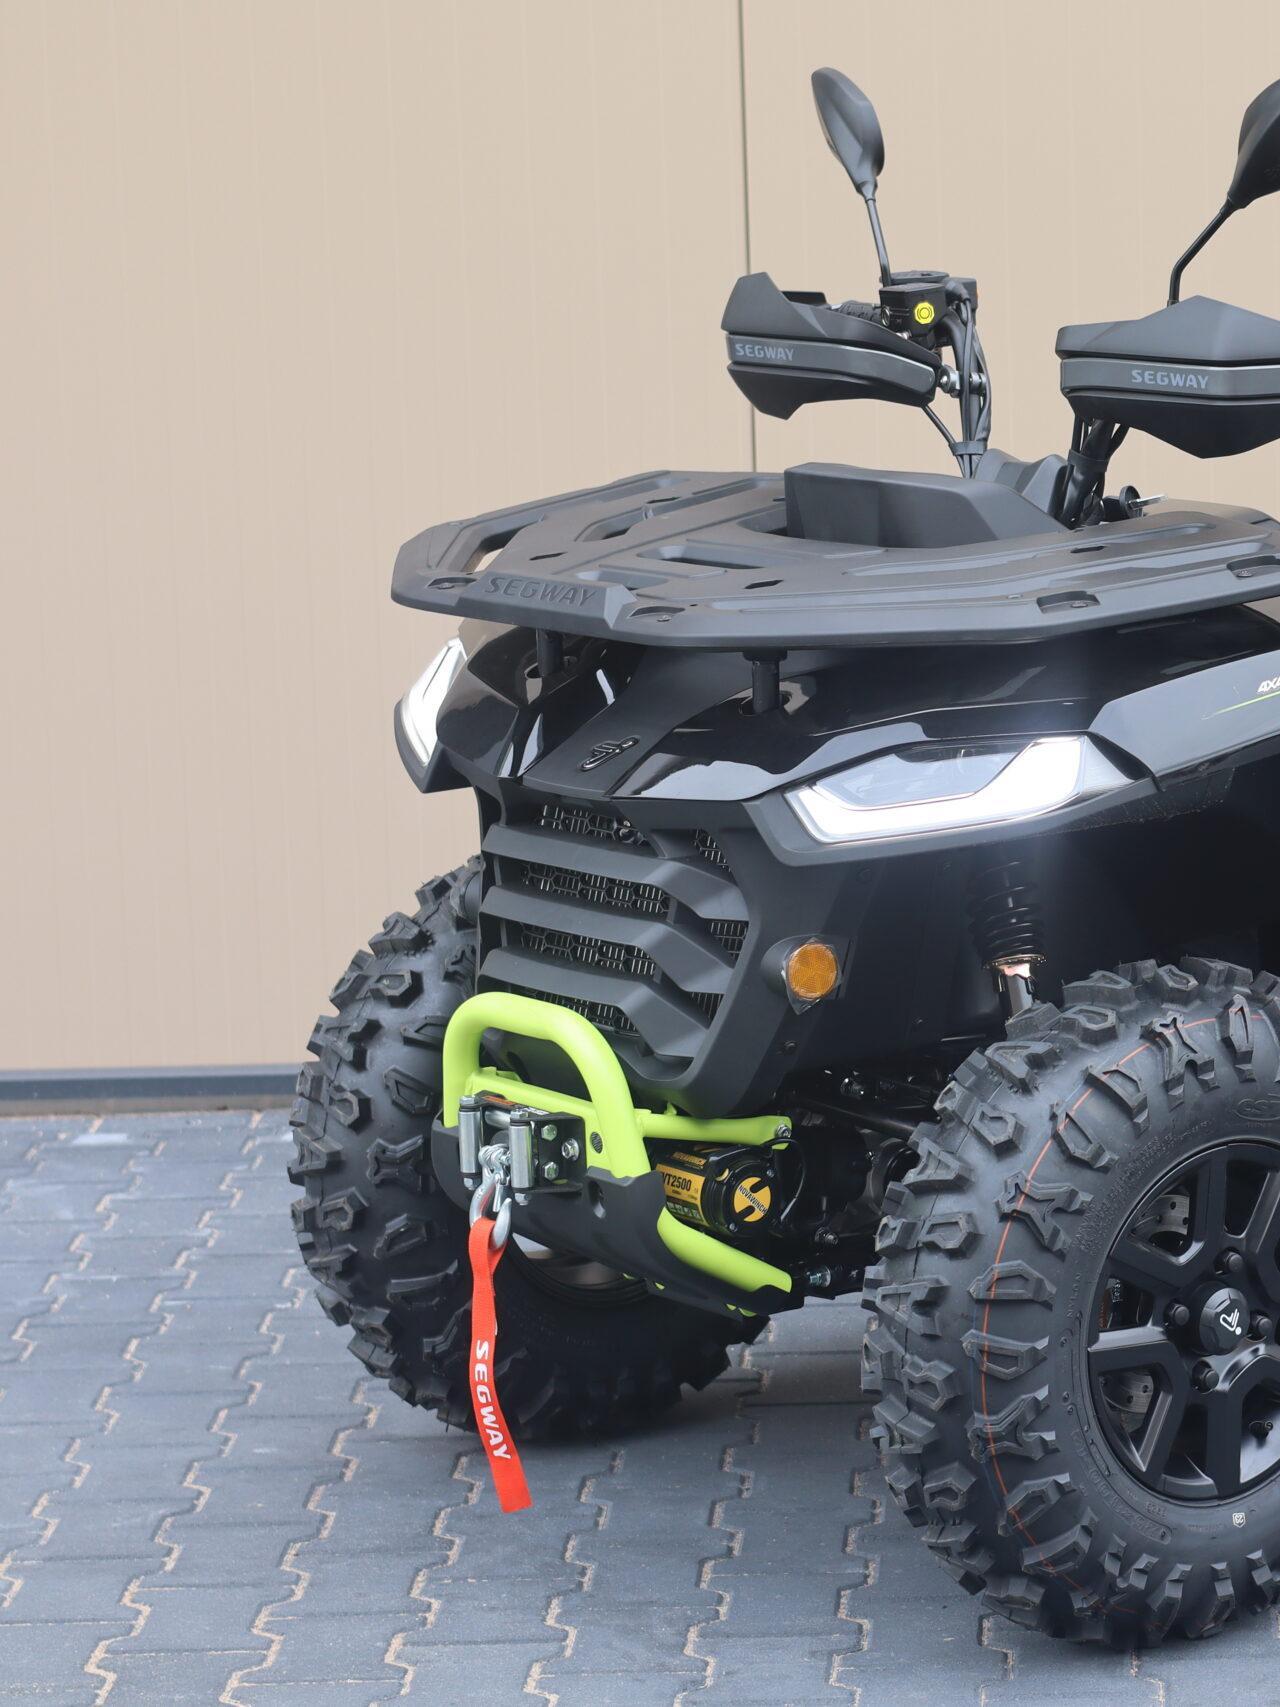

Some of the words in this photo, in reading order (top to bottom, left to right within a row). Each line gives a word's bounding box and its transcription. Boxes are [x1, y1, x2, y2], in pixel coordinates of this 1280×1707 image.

[734, 343, 794, 361] SEGWAY
[1131, 369, 1209, 389] SEGWAY
[485, 576, 598, 607] SEGWAY
[738, 1184, 769, 1216] NOVAWINCH
[475, 1340, 512, 1460] SEGWAY
